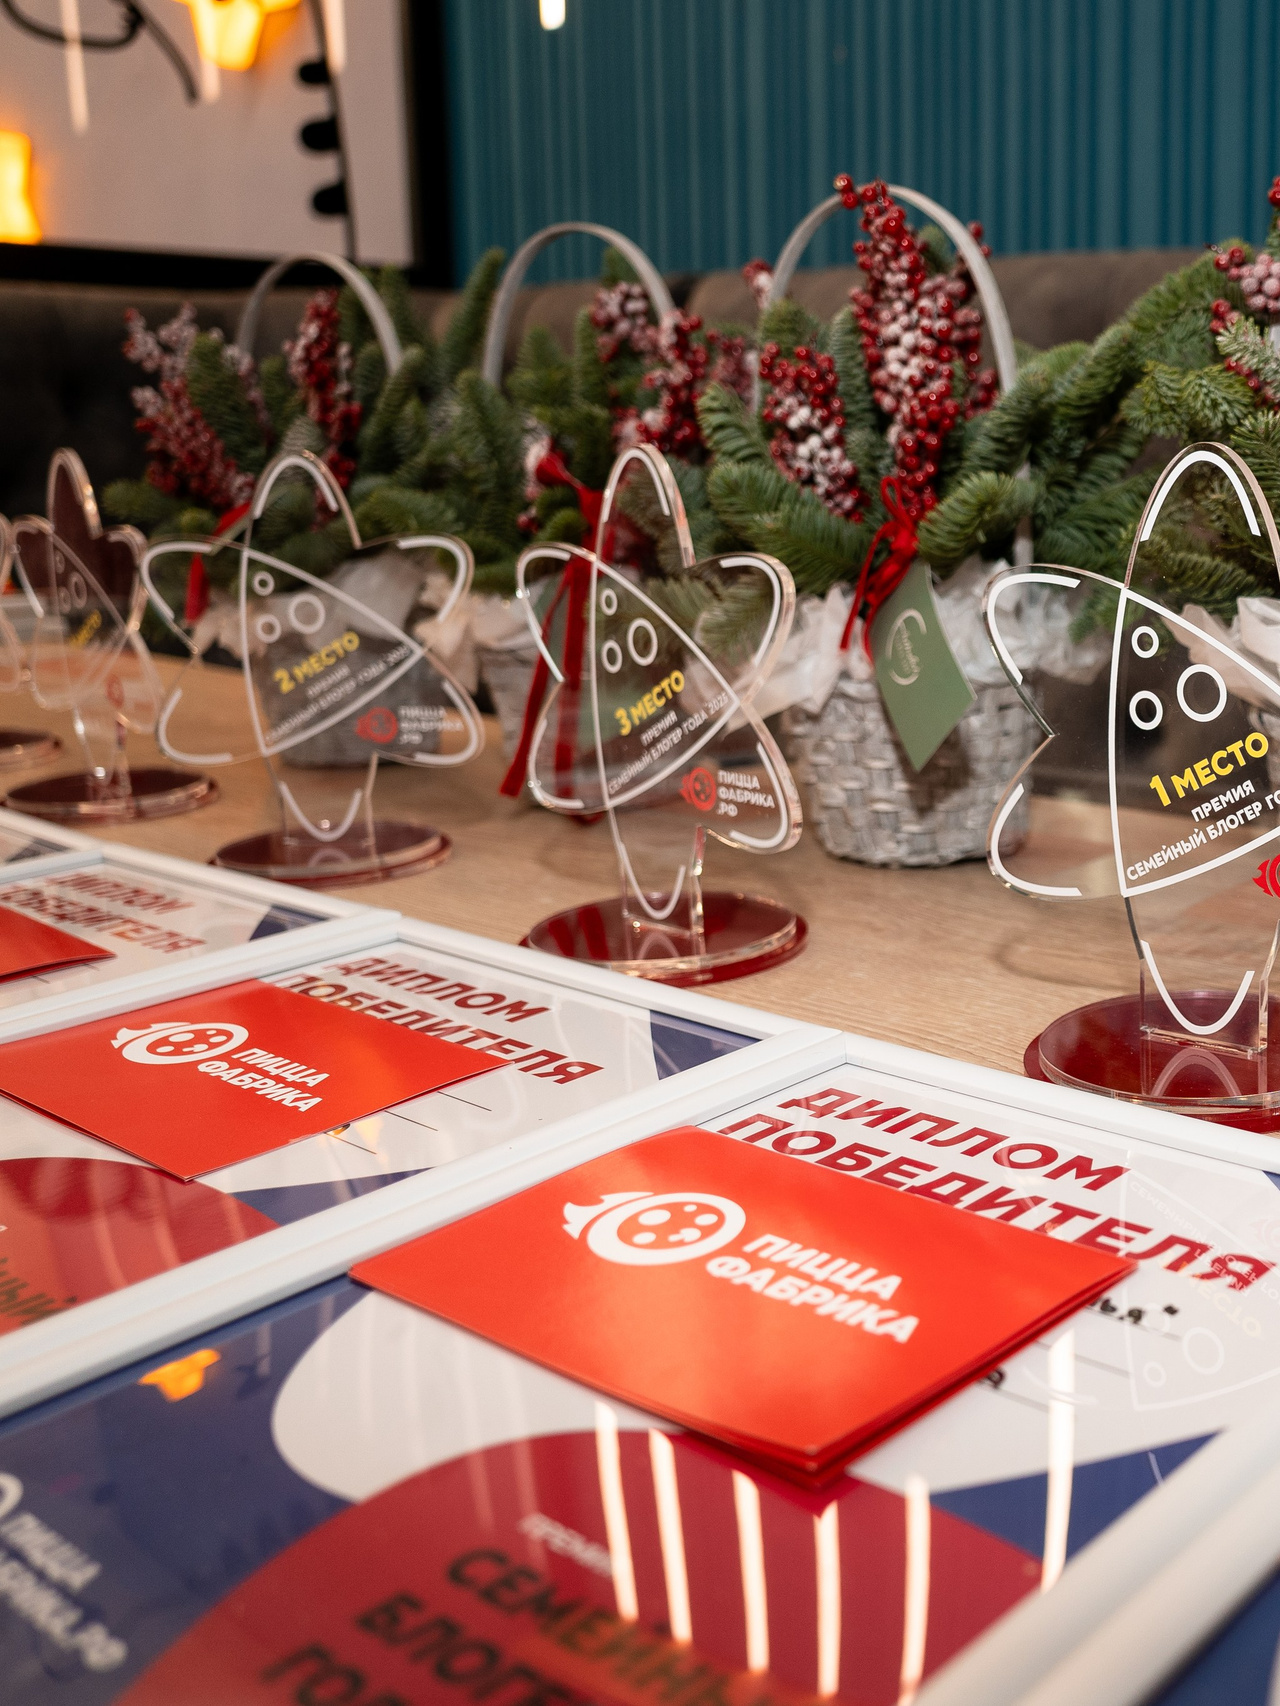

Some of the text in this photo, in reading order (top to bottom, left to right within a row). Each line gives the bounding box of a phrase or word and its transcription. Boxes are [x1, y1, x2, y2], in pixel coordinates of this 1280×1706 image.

[273, 630, 360, 694] 2 МЕСТО
[614, 669, 686, 736] 3 МЕСТО
[640, 710, 678, 746] ПРЕМИЯ
[608, 749, 653, 795] СЕМЕЙНЫЙ
[651, 727, 683, 761] БЛОГЕР
[682, 710, 708, 736] ГОДА
[717, 770, 761, 790] ПИЦЦА
[1149, 731, 1270, 807] 1 МЕСТО
[717, 787, 776, 809] ФАБРИКА
[717, 803, 739, 818] .РФ
[1191, 779, 1256, 822] ПРЕМИЯ
[1125, 827, 1207, 882] СЕМЕЙНЫЙ
[1207, 801, 1263, 841] БЛОГЕР
[324, 957, 552, 1023] ДИПЛОМ
[197, 1061, 323, 1112] ФАБРИКА
[231, 1048, 330, 1087] ПИЦЦА
[776, 1088, 1130, 1192] ДИПЛОМ
[717, 1113, 1278, 1291] ПОБЕДИТЕЛЯ
[706, 1256, 920, 1343] ФАБРИКА
[742, 1233, 902, 1300] ПИЦЦА
